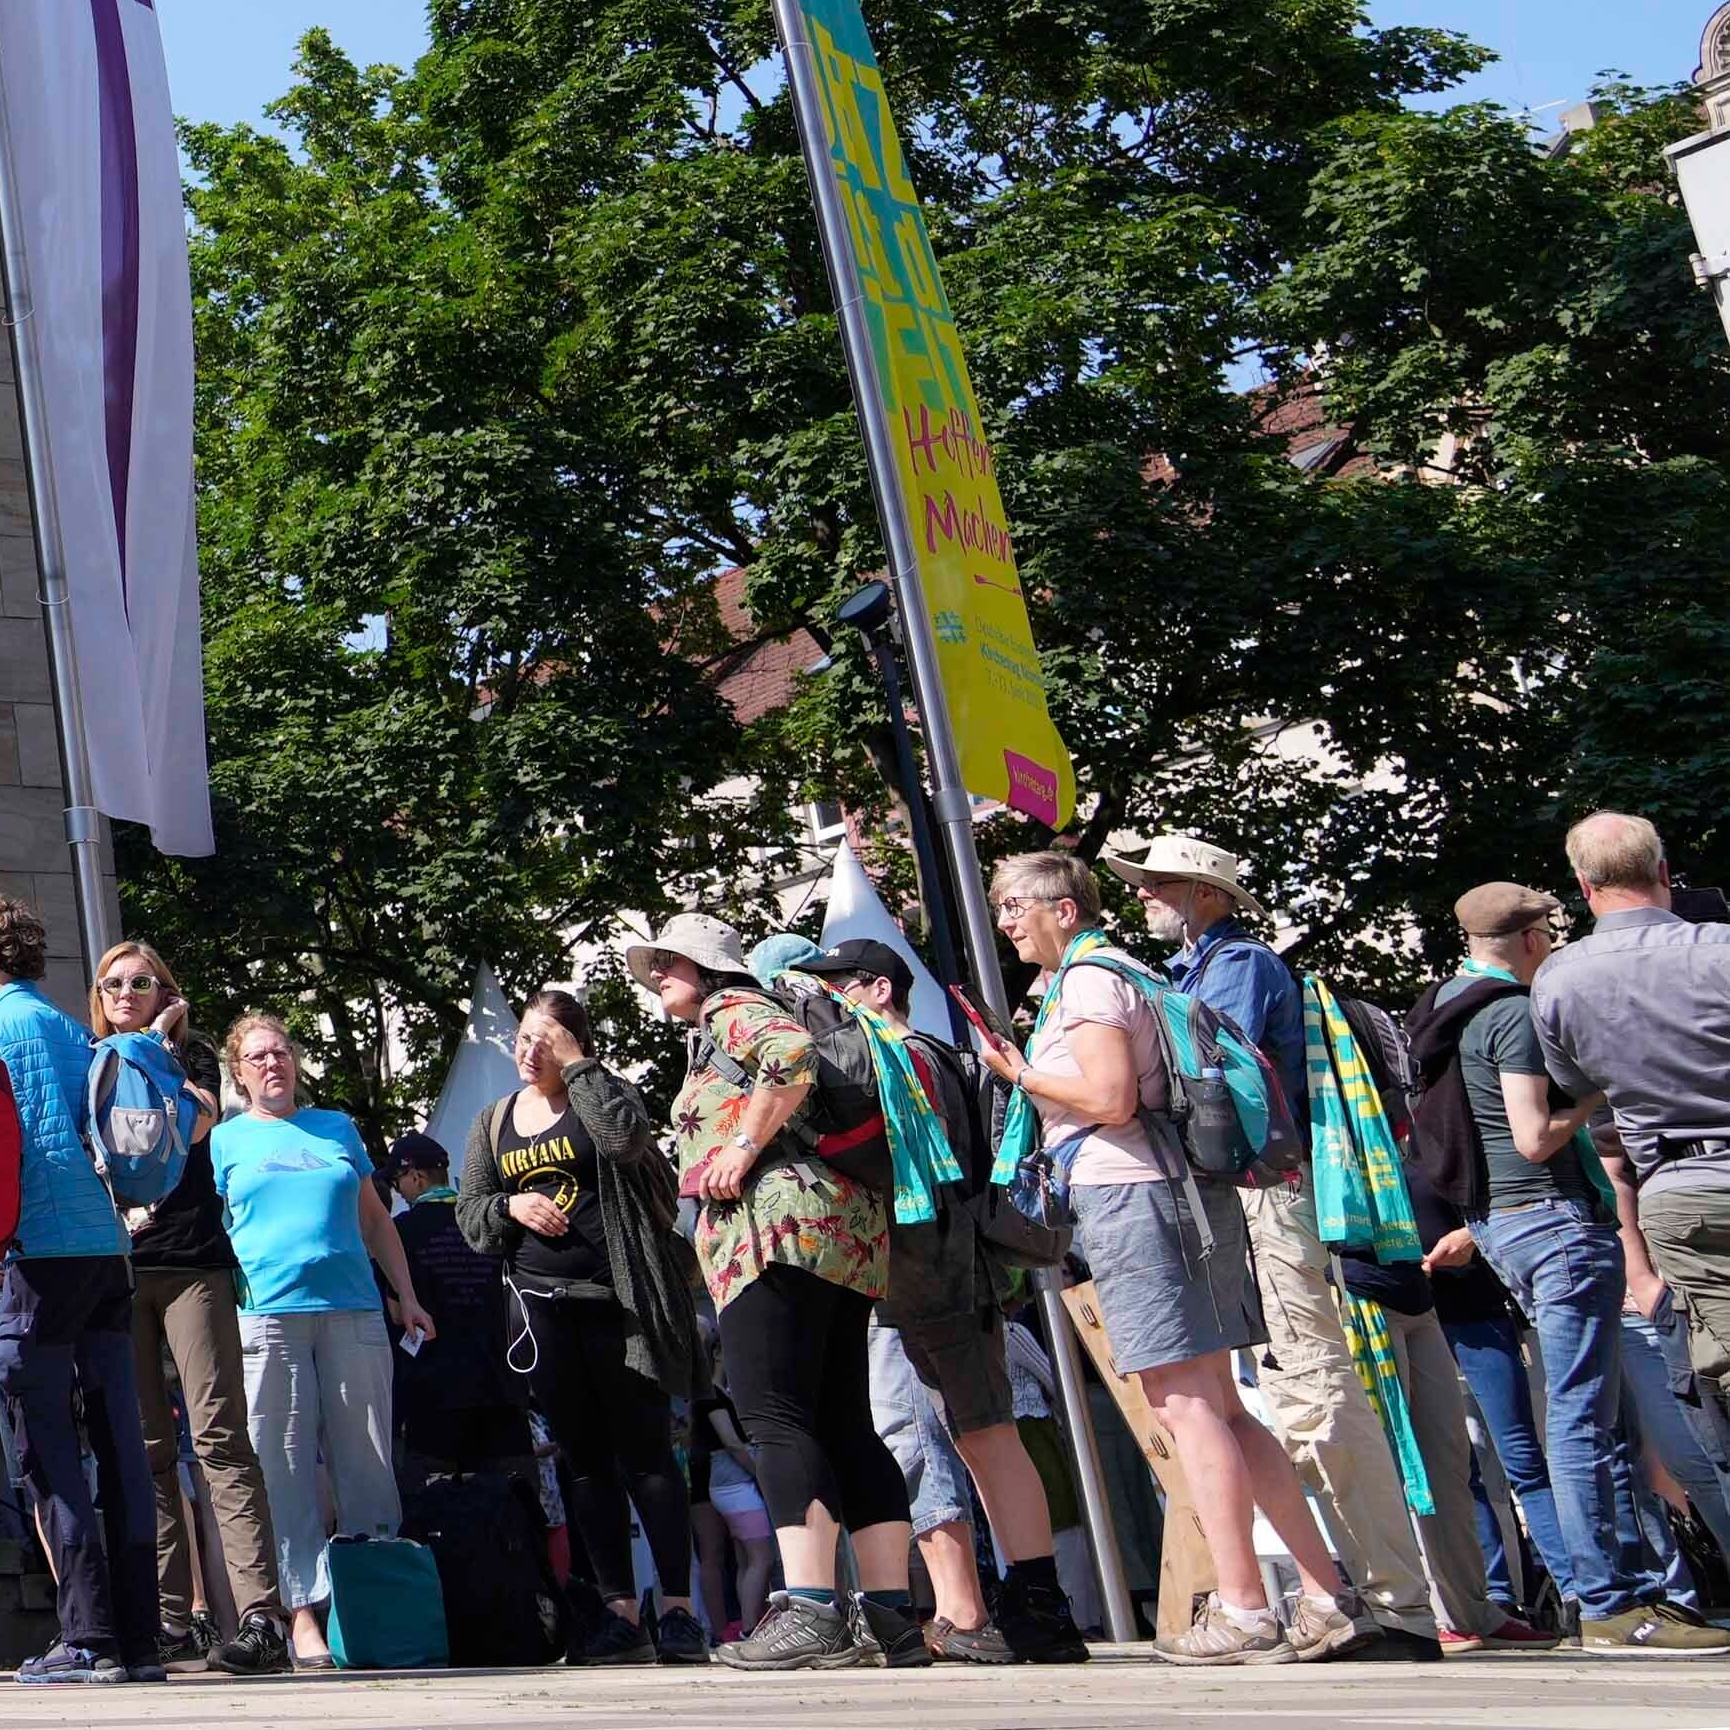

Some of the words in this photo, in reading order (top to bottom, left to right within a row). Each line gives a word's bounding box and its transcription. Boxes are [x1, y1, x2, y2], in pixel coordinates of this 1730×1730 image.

[903, 403, 995, 480] Hoffen
[924, 489, 1012, 563] Machen
[501, 1136, 576, 1179] NIRVANA
